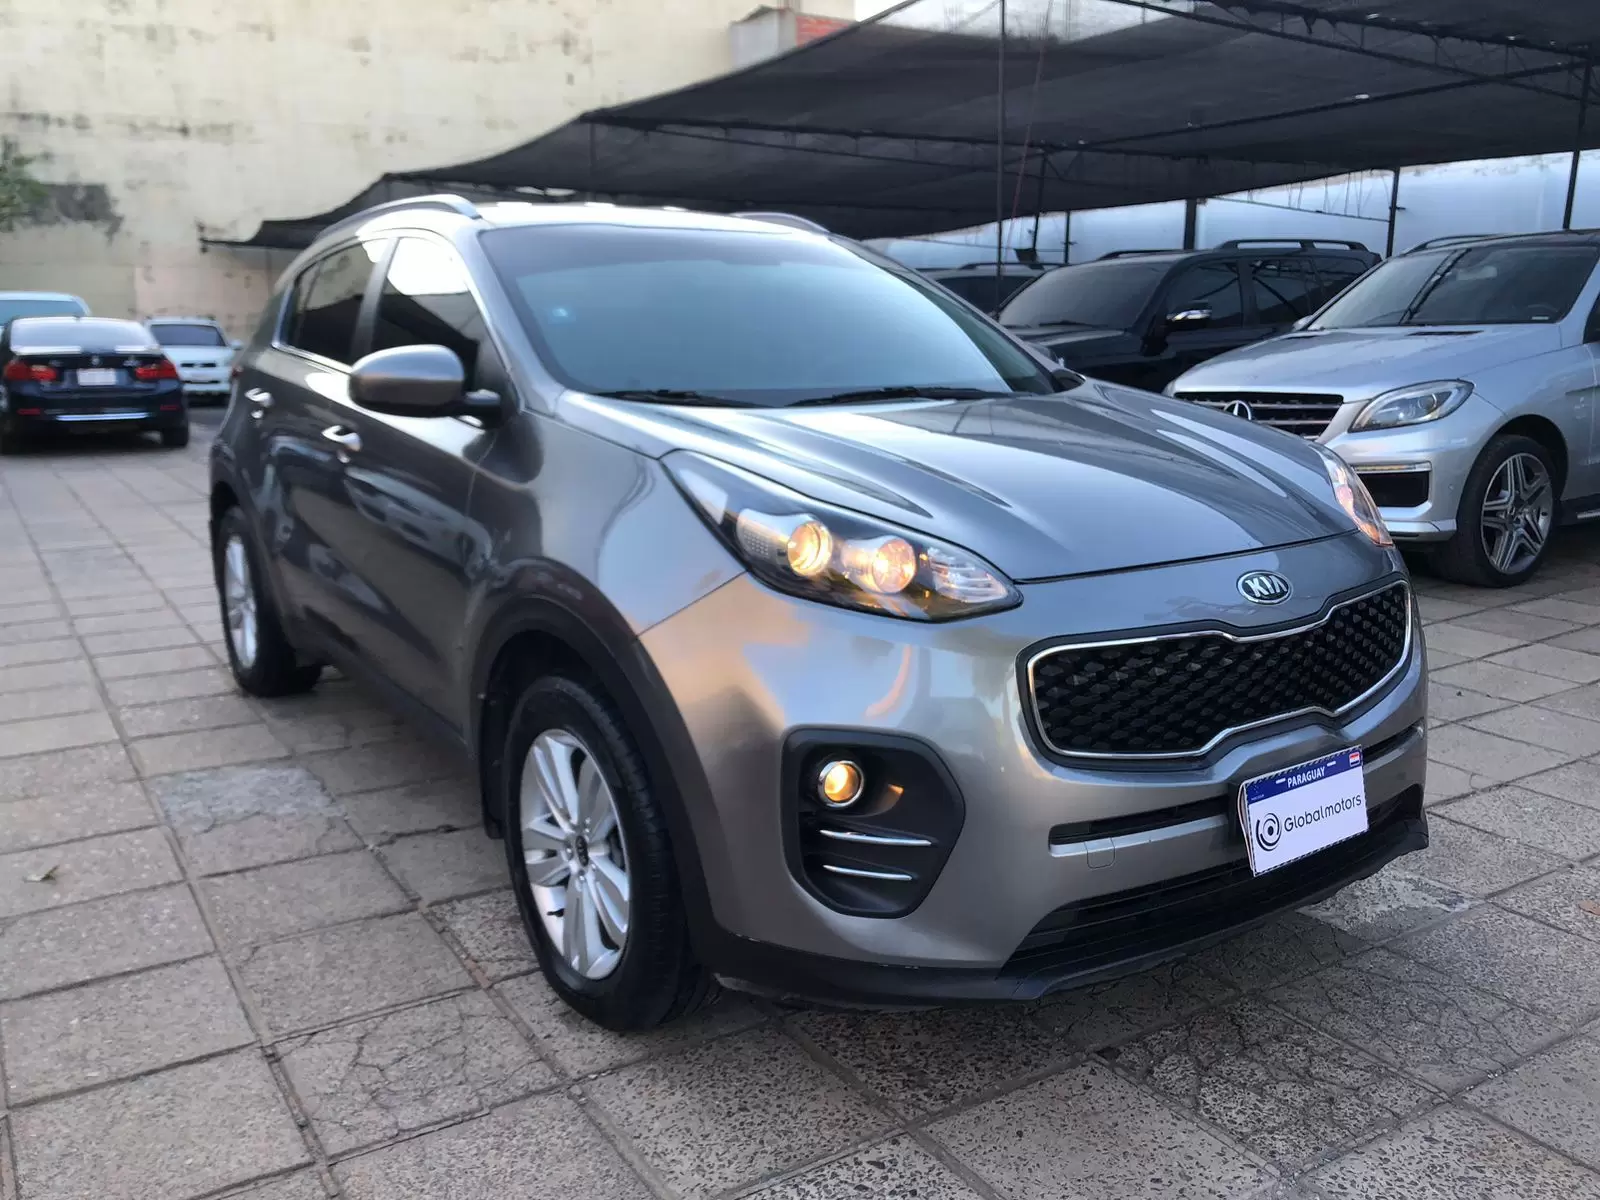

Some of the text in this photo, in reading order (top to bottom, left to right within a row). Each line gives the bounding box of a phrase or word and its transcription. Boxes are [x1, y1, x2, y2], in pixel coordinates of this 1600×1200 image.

[1245, 575, 1287, 597] KIA
[1287, 766, 1326, 788] PARAGUAY
[1284, 794, 1361, 832] Globalmotors
